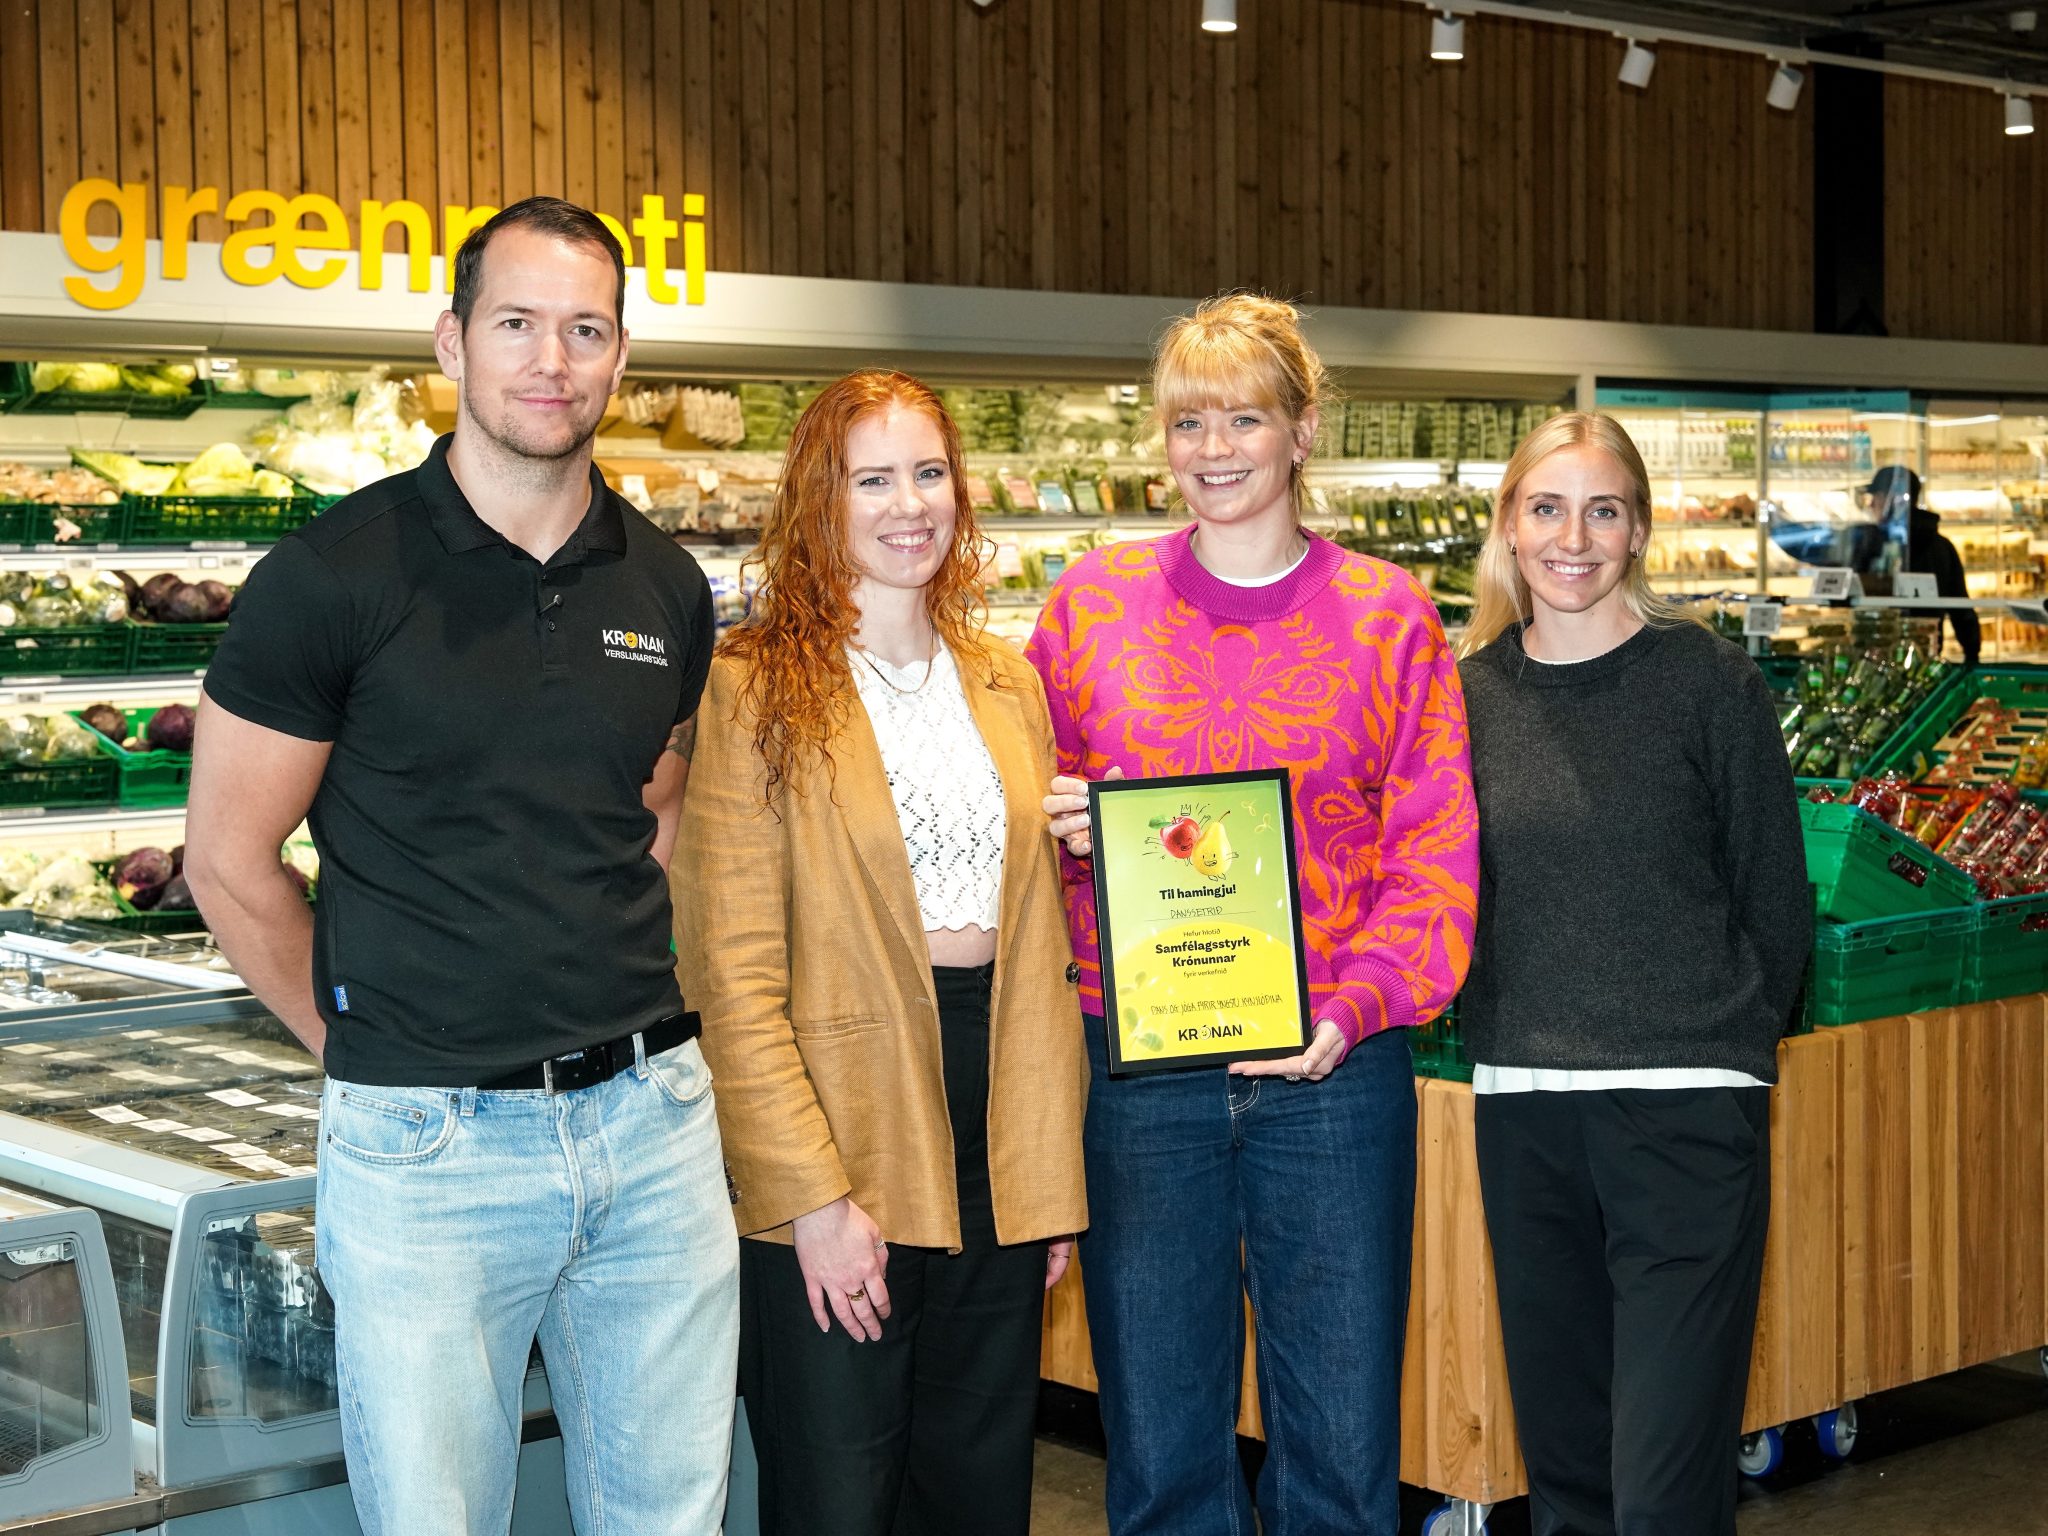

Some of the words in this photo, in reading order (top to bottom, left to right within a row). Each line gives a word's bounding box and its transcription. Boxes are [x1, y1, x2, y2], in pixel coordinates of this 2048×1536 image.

[60, 178, 705, 309] grænti
[1159, 888, 1175, 900] Til
[1177, 884, 1236, 898] hamingju!
[1183, 929, 1201, 937] Hefur
[1201, 928, 1221, 936] hlotið
[1155, 936, 1251, 954] Samfélagsstyrk
[1172, 953, 1236, 968] Krónunnar
[1183, 971, 1197, 979] fyrir
[1197, 968, 1227, 977] verkefnið
[1151, 1005, 1168, 1015] DANS
[1169, 1004, 1179, 1014] OG
